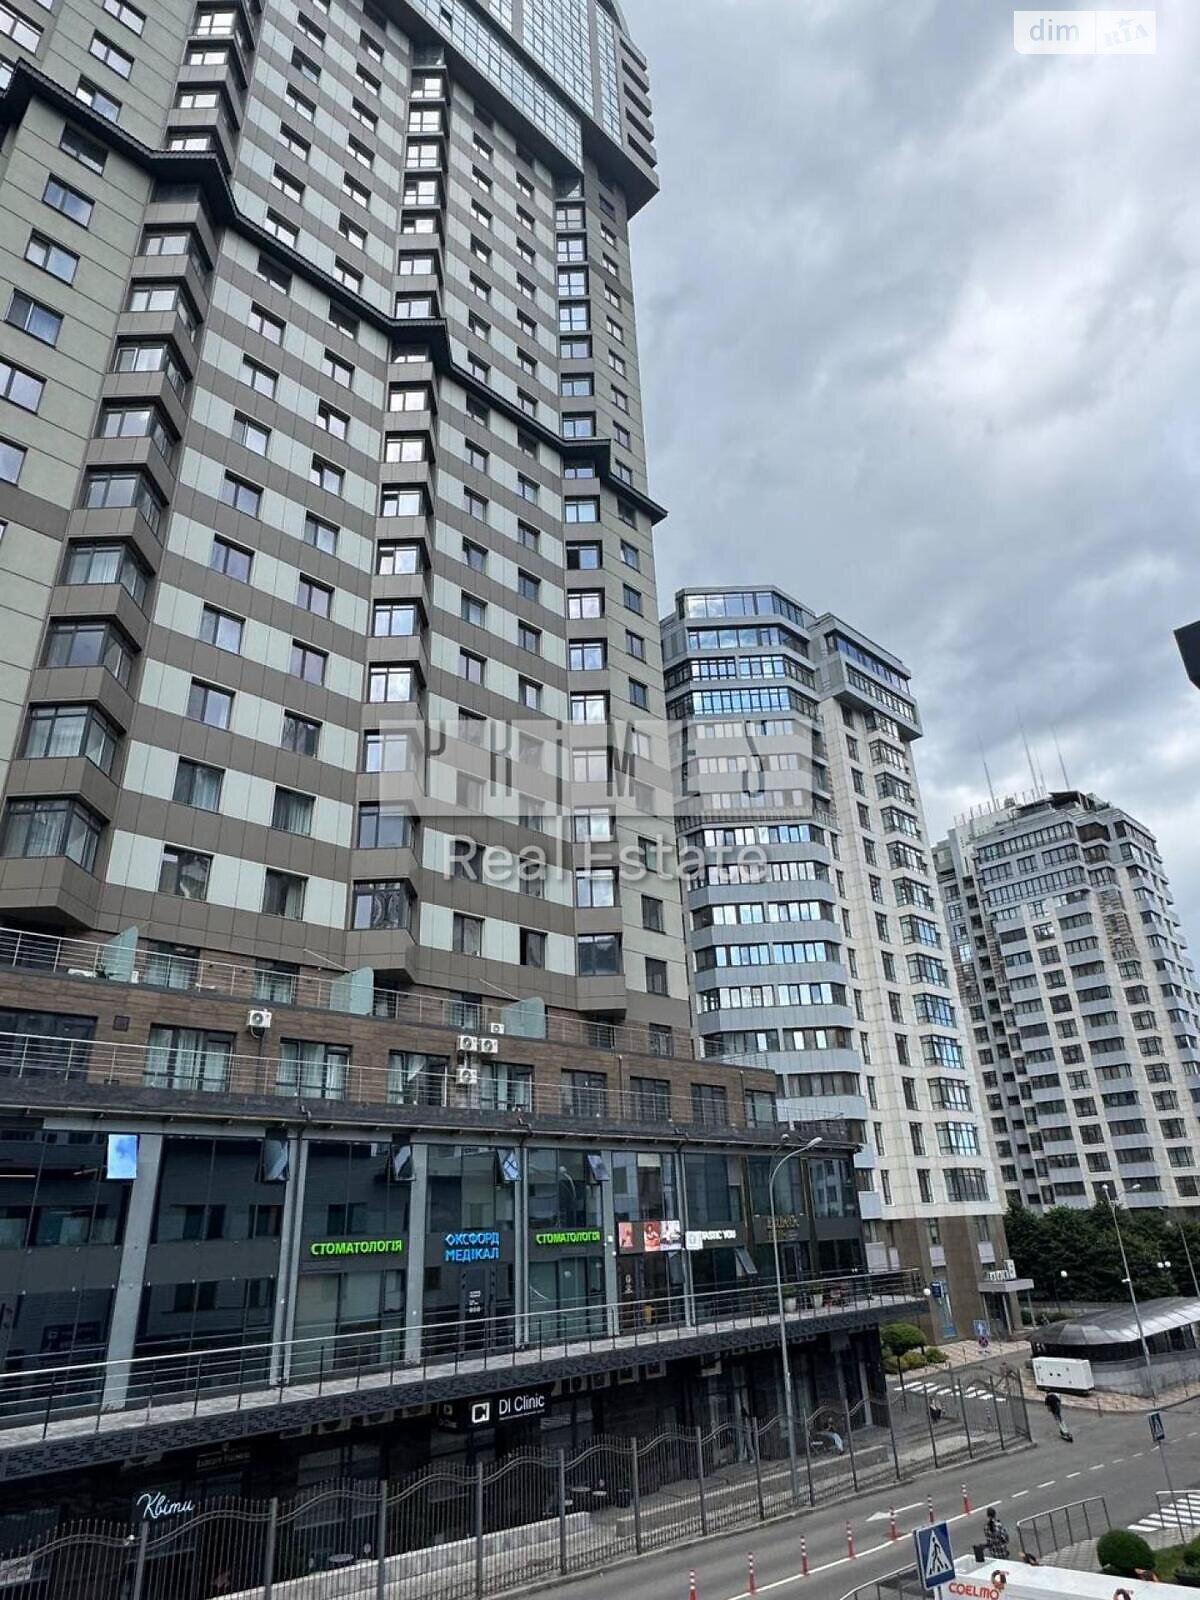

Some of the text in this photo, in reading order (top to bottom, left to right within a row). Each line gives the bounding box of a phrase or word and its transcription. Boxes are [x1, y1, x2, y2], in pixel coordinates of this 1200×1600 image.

[445, 1232, 500, 1246] ОКСФОРД
[535, 1231, 601, 1245] СТОМАТОЛОГІЯ
[311, 1239, 402, 1255] СТОМАТОЛОГІЯ
[445, 1247, 500, 1262] МЕДІКАЛ
[514, 1392, 545, 1412] Clinic
[136, 1491, 195, 1519] Квіти
[948, 1582, 1000, 1600] COELMO
